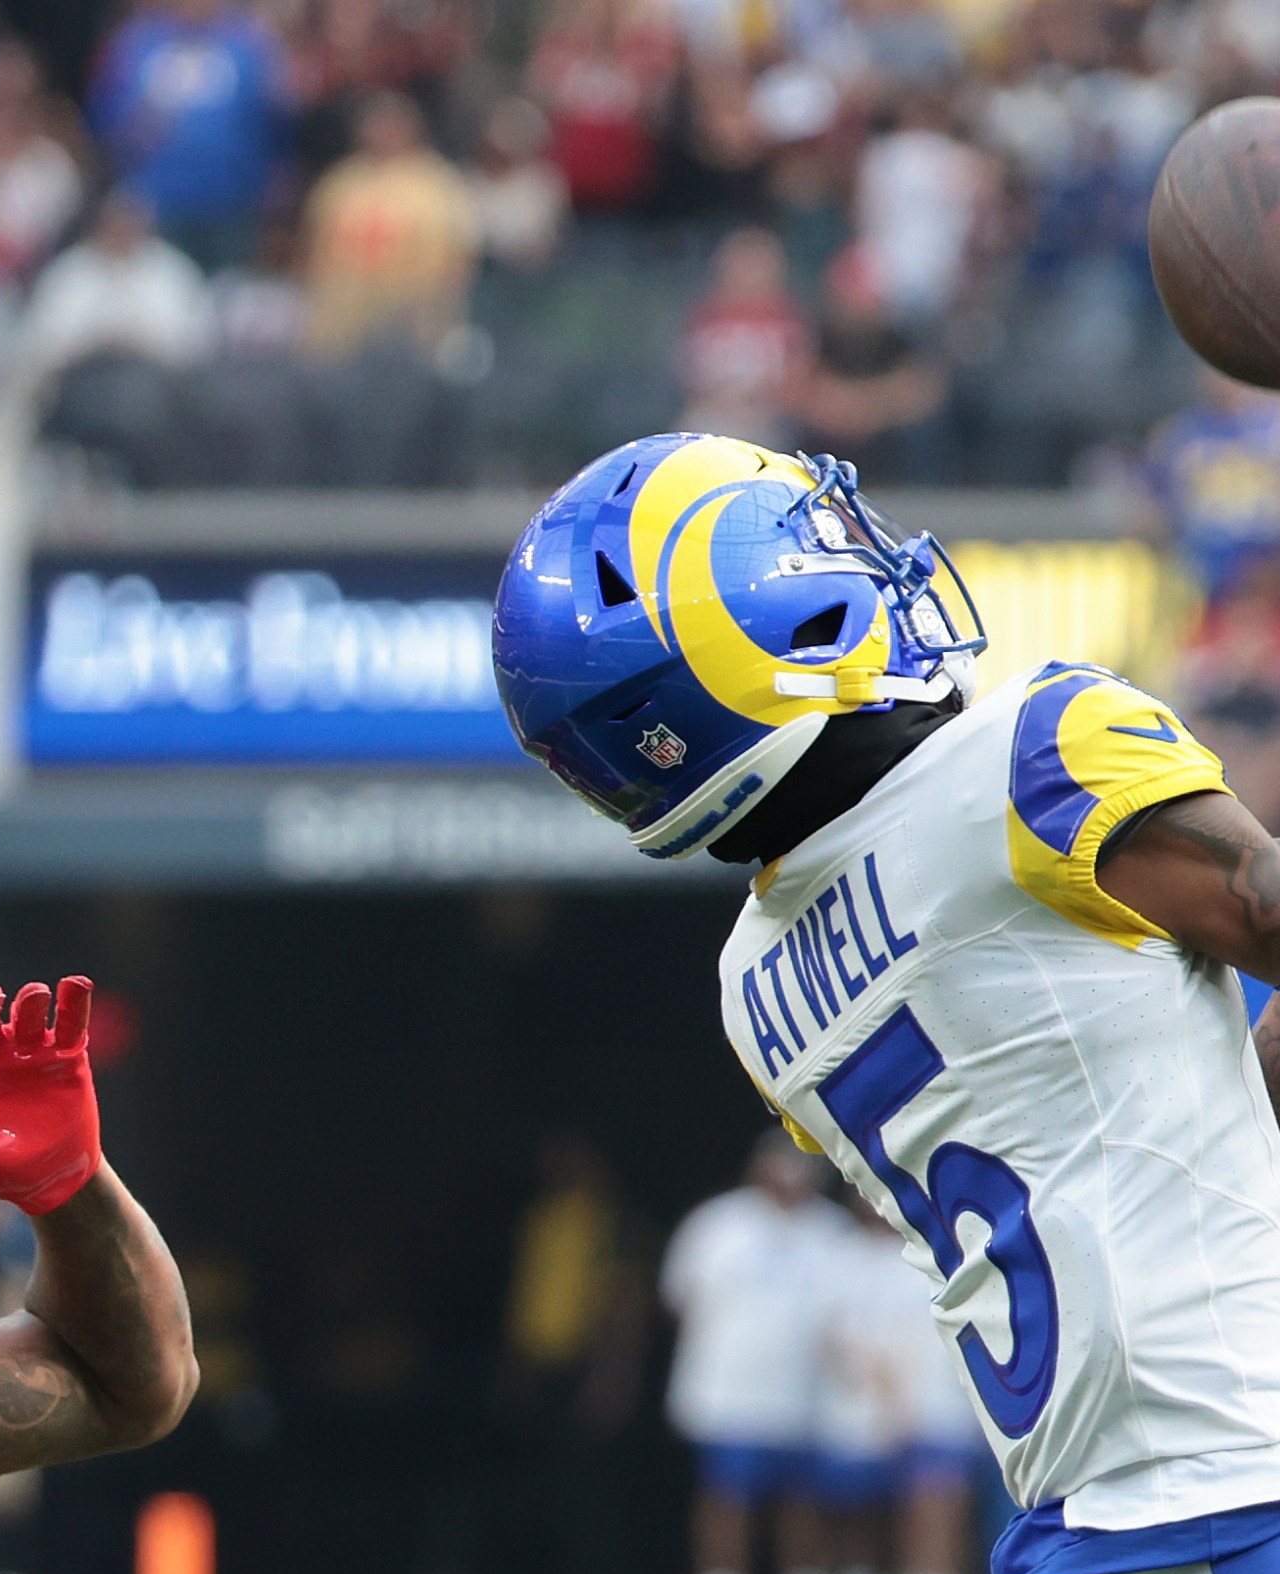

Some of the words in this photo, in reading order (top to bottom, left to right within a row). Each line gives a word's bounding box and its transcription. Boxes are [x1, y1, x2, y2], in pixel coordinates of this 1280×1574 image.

[653, 741, 681, 764] NFL
[742, 851, 920, 1081] ATWELL
[815, 1003, 1060, 1440] 5
